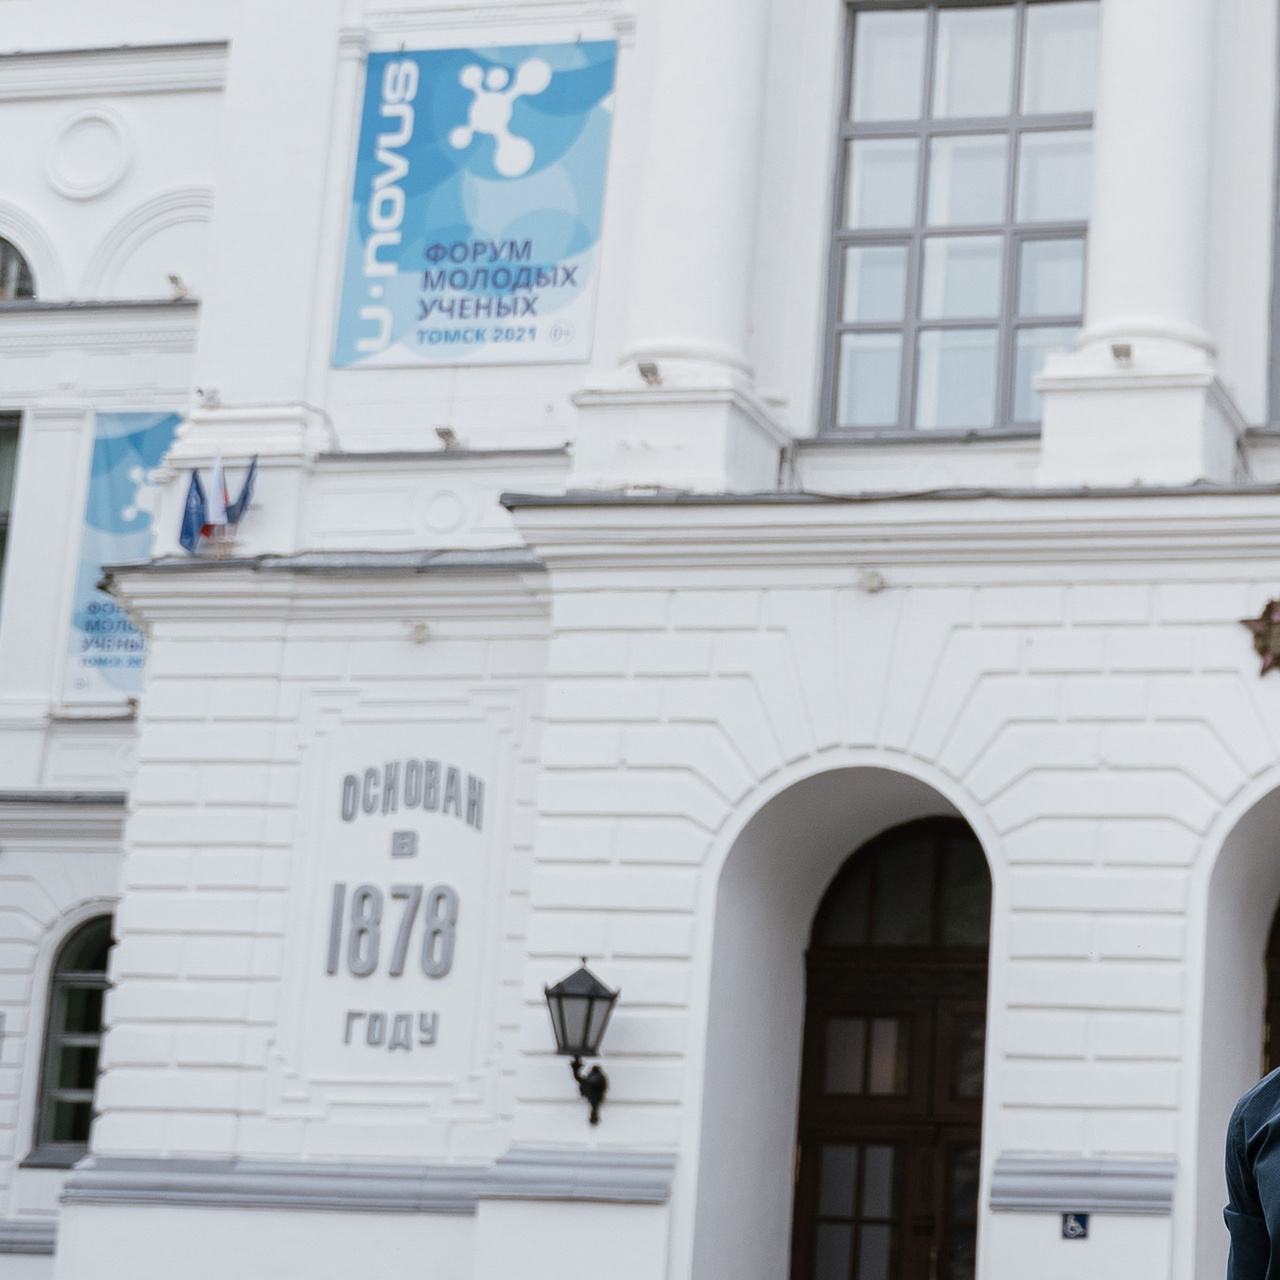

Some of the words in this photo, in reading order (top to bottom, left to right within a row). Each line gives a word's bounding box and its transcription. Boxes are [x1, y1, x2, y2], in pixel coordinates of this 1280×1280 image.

[425, 240, 533, 263] ФОРУМ
[423, 266, 579, 293] МОЛОДЫХ
[418, 296, 540, 321] УЧЕНЫХ
[417, 328, 487, 345] ТОМСК
[493, 327, 537, 342] 2021
[81, 637, 145, 653] УЧЕНЫ
[341, 758, 485, 831] ОСНОВАН
[391, 830, 418, 857] В
[327, 882, 460, 978] 1878
[345, 1010, 439, 1052] ГОДУ
